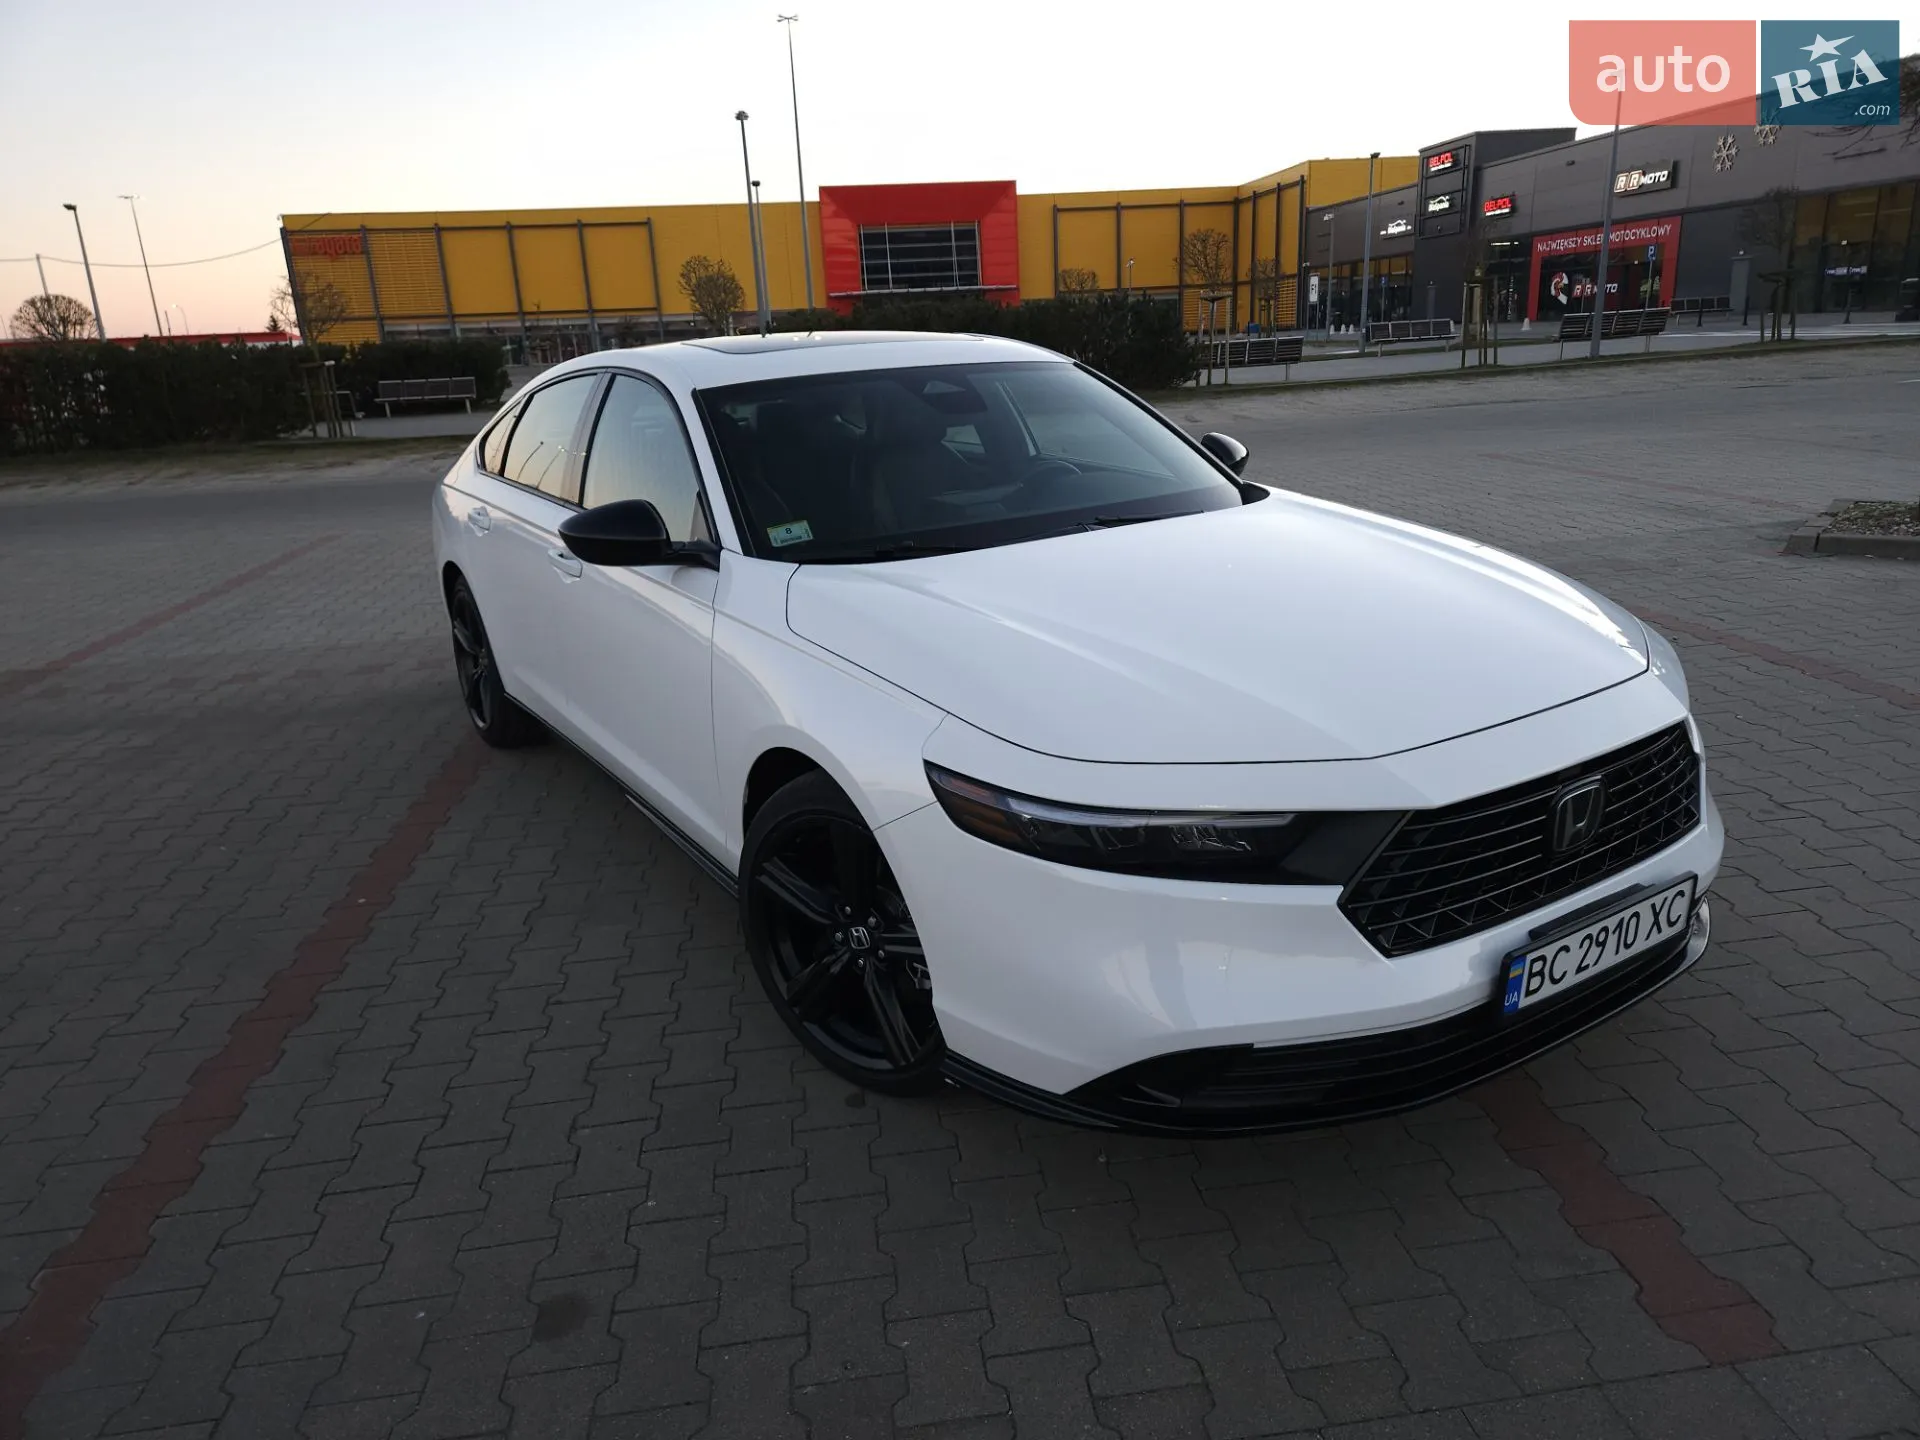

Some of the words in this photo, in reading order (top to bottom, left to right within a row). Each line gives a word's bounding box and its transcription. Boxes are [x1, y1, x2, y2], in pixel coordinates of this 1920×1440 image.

[1609, 224, 1672, 242] MOTOCYKLOWY
[1524, 945, 1571, 998] BC
[1574, 910, 1641, 975] 2910
[1644, 889, 1686, 941] XC
[1504, 993, 1518, 1006] UA
